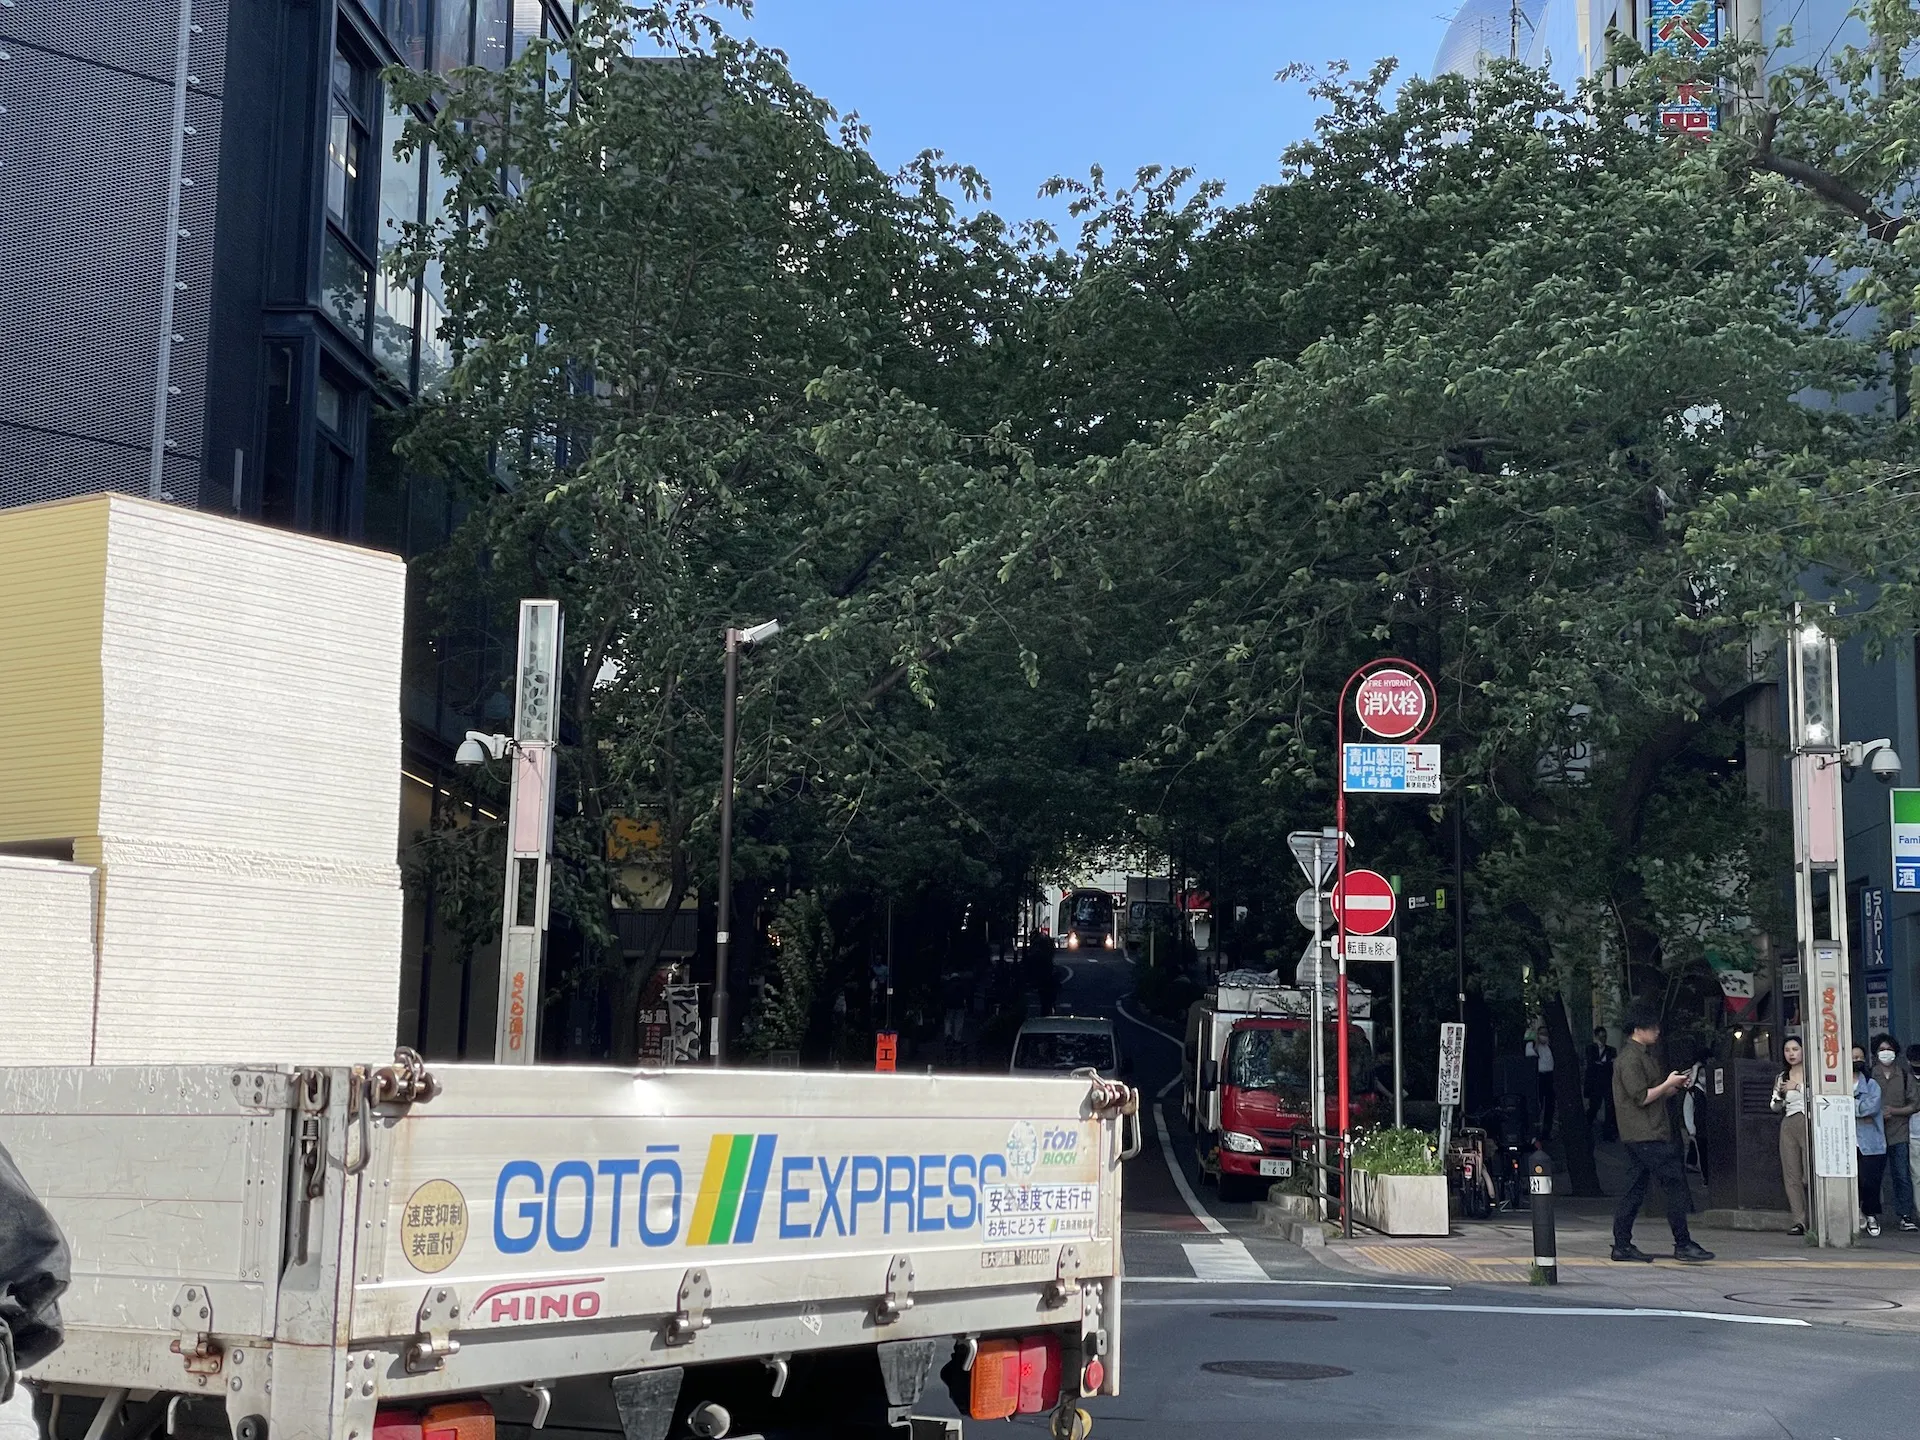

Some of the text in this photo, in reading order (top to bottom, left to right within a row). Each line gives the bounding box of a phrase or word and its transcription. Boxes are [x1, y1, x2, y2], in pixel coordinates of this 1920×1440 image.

[1368, 679, 1412, 687] FIRE HYDRANT
[1363, 690, 1419, 716] 消火栓
[1349, 747, 1404, 766] 青山製図
[1348, 766, 1404, 777] 専門学校
[1361, 777, 1392, 788] 1号館
[1898, 868, 1916, 887] 酒
[1872, 890, 1884, 965] SAPIX
[1346, 941, 1392, 956] 転車を除く
[989, 1186, 1092, 1213] 安全速度で走行中
[407, 1202, 463, 1228] 速度抑制
[987, 1217, 1047, 1237] お先にどうぞ
[412, 1231, 455, 1257] 装置付
[491, 1291, 601, 1322] HINO
